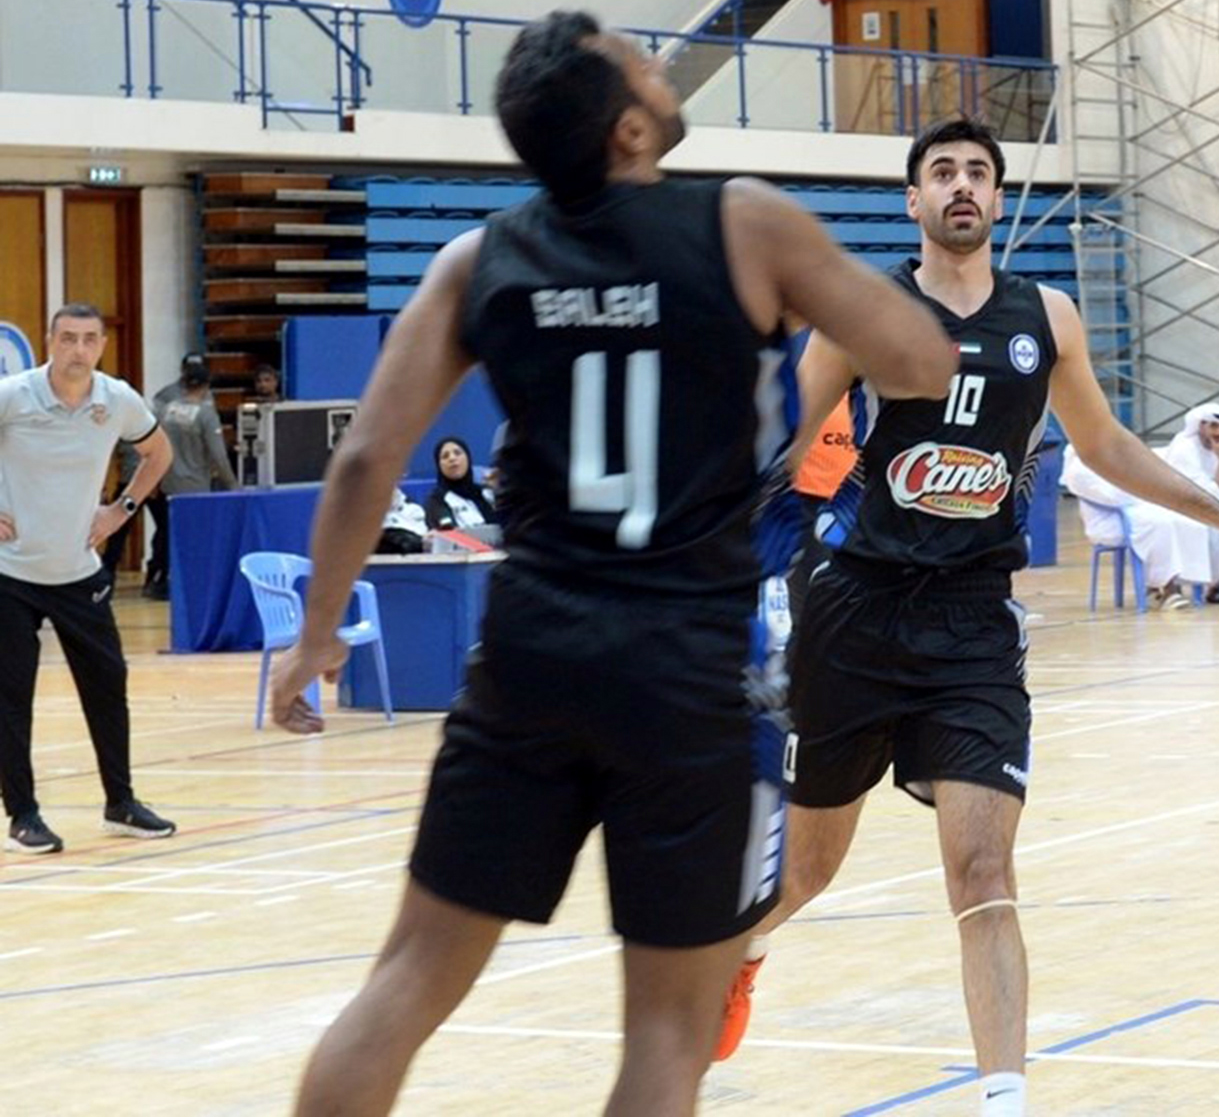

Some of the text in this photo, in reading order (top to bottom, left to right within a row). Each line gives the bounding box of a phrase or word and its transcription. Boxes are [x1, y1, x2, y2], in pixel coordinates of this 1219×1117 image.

[530, 282, 660, 328] SALEH
[944, 374, 986, 426] 10
[569, 350, 661, 550] 4
